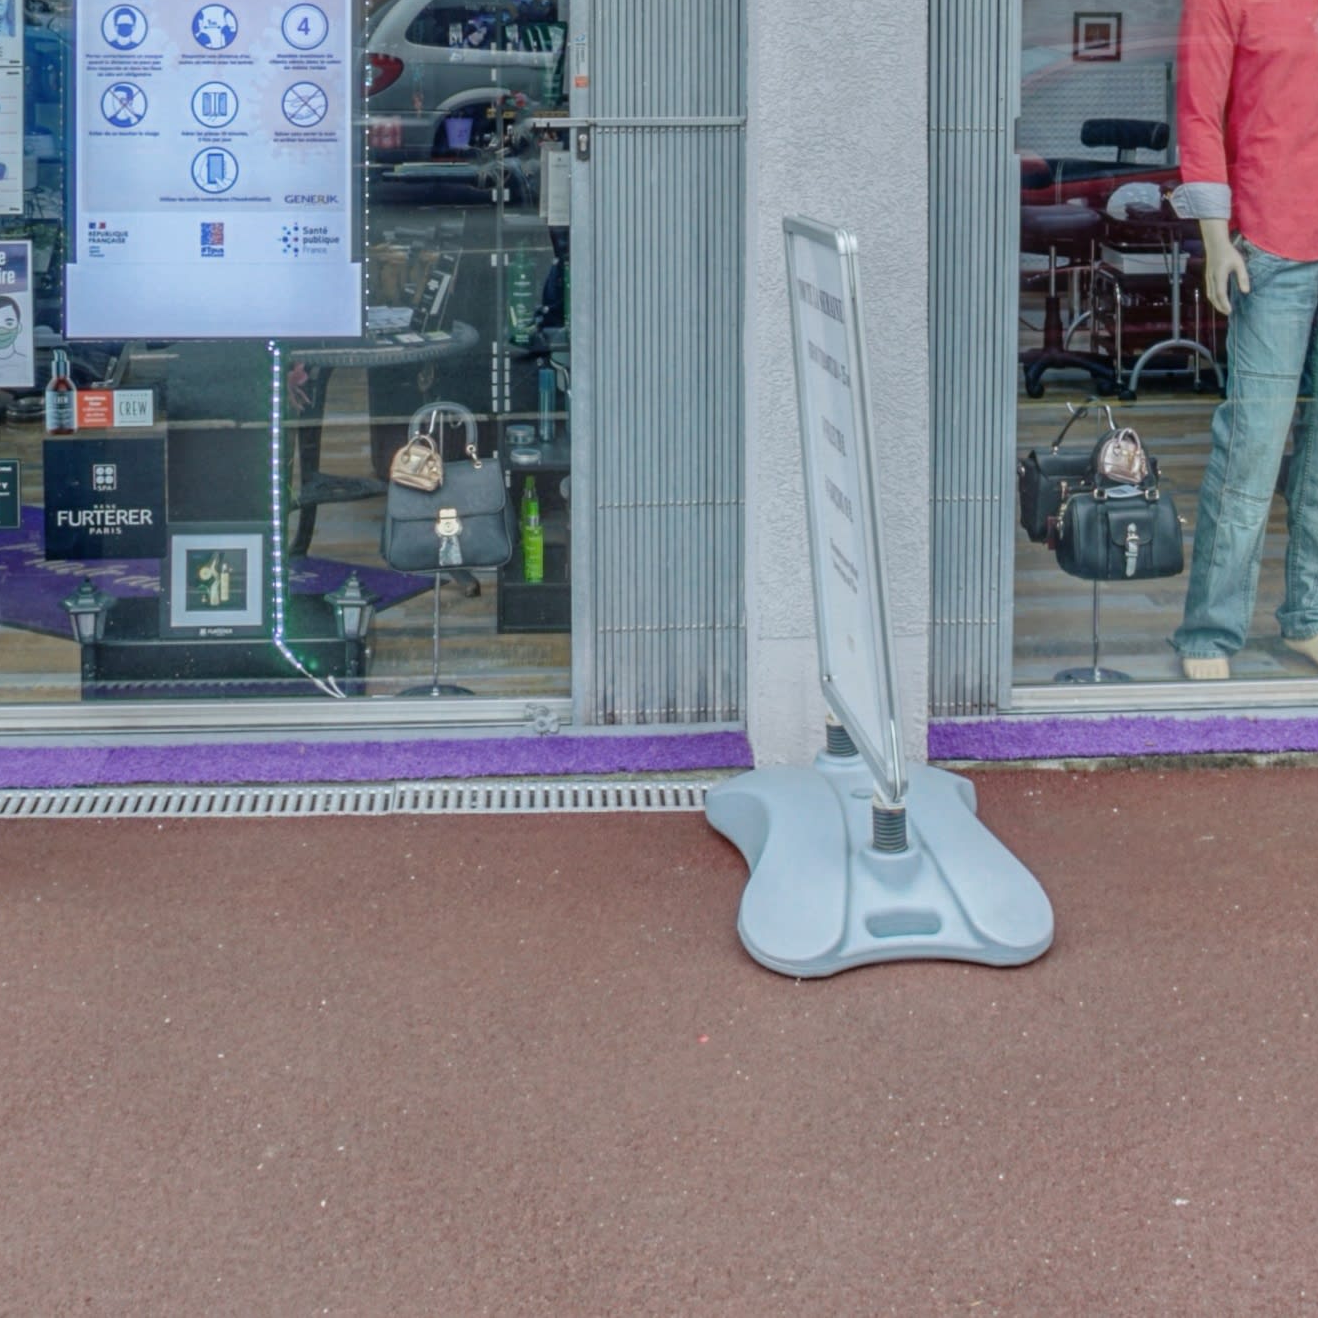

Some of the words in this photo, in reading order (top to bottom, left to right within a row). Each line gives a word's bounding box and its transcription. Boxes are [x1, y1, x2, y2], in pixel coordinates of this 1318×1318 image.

[297, 17, 311, 35] 4
[284, 194, 339, 205] GENERIK
[302, 225, 328, 235] Santé
[302, 235, 340, 245] publique
[119, 401, 148, 416] CREW
[57, 508, 154, 526] FURTERER
[89, 527, 122, 535] PARIS
